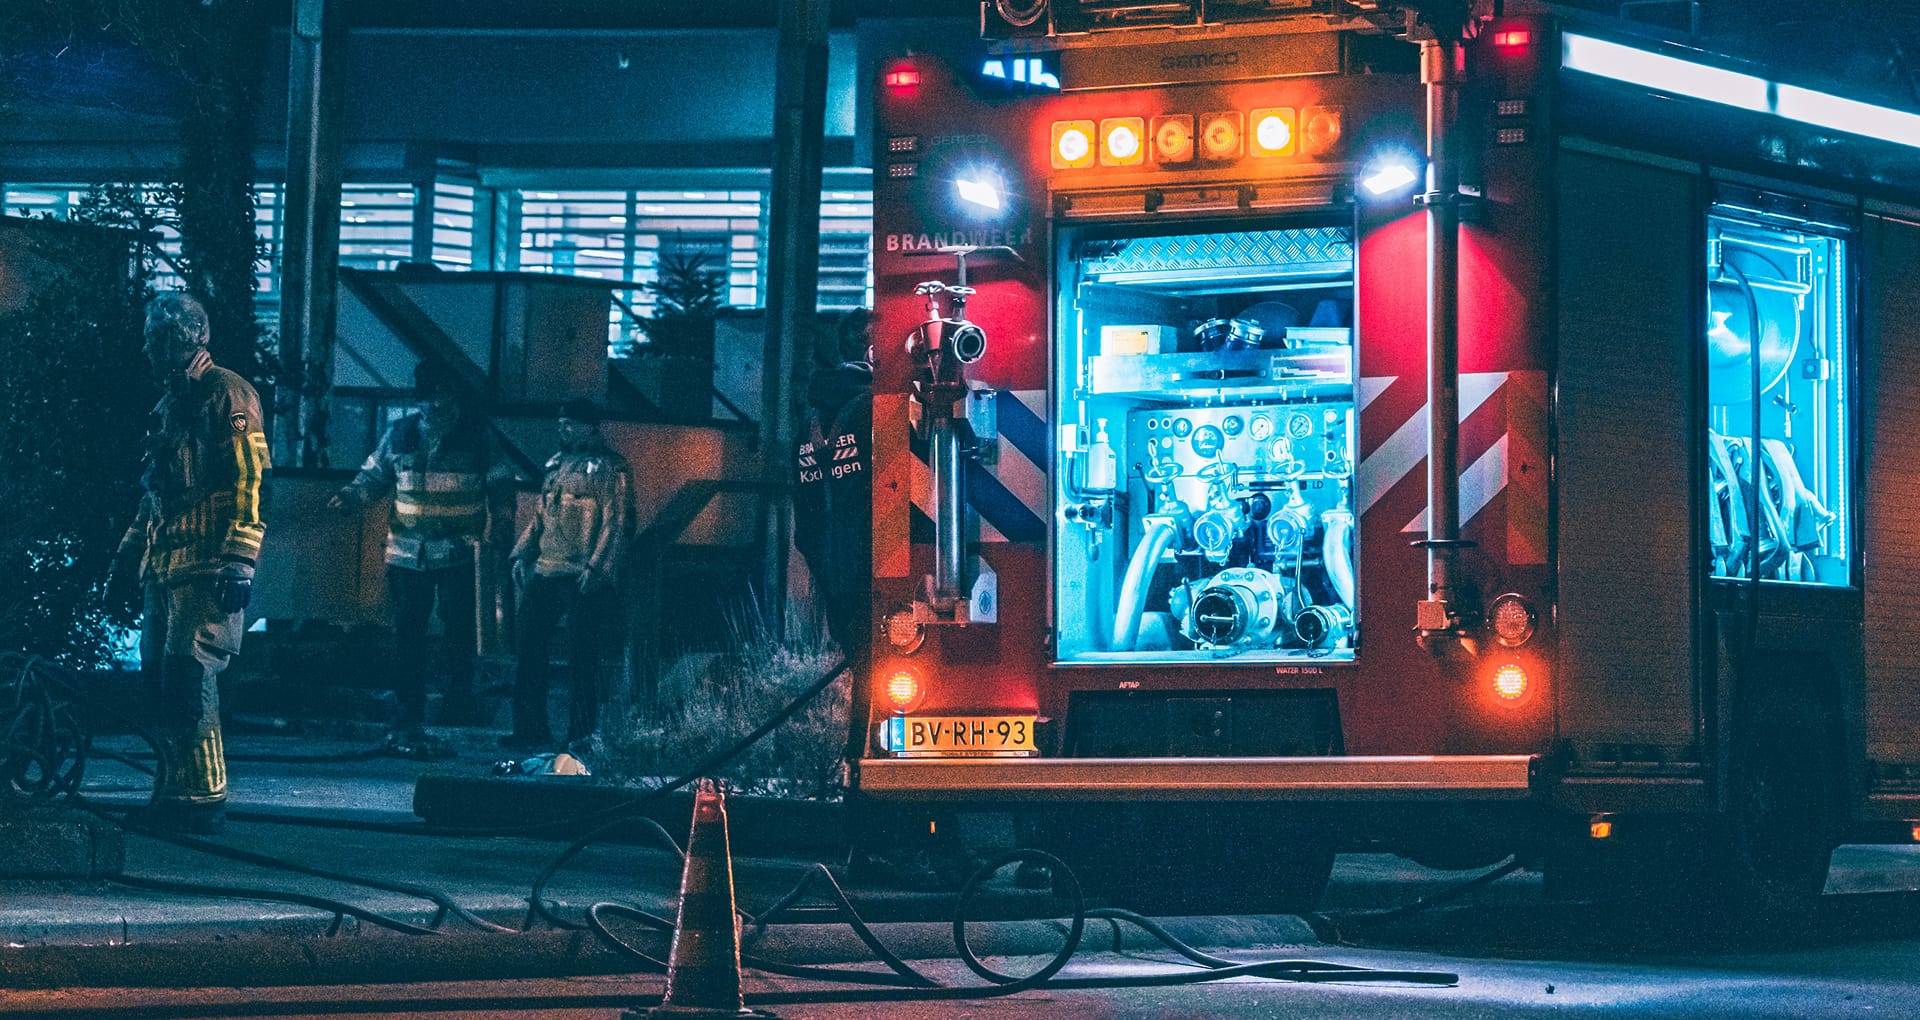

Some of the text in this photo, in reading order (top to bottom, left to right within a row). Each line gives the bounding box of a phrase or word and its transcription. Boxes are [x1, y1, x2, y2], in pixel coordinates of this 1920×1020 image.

[1159, 52, 1239, 70] GEMCO
[886, 228, 1032, 251] BRANDWEER
[1119, 681, 1140, 689] AFTAP
[911, 721, 1026, 746] BV-RH-93
